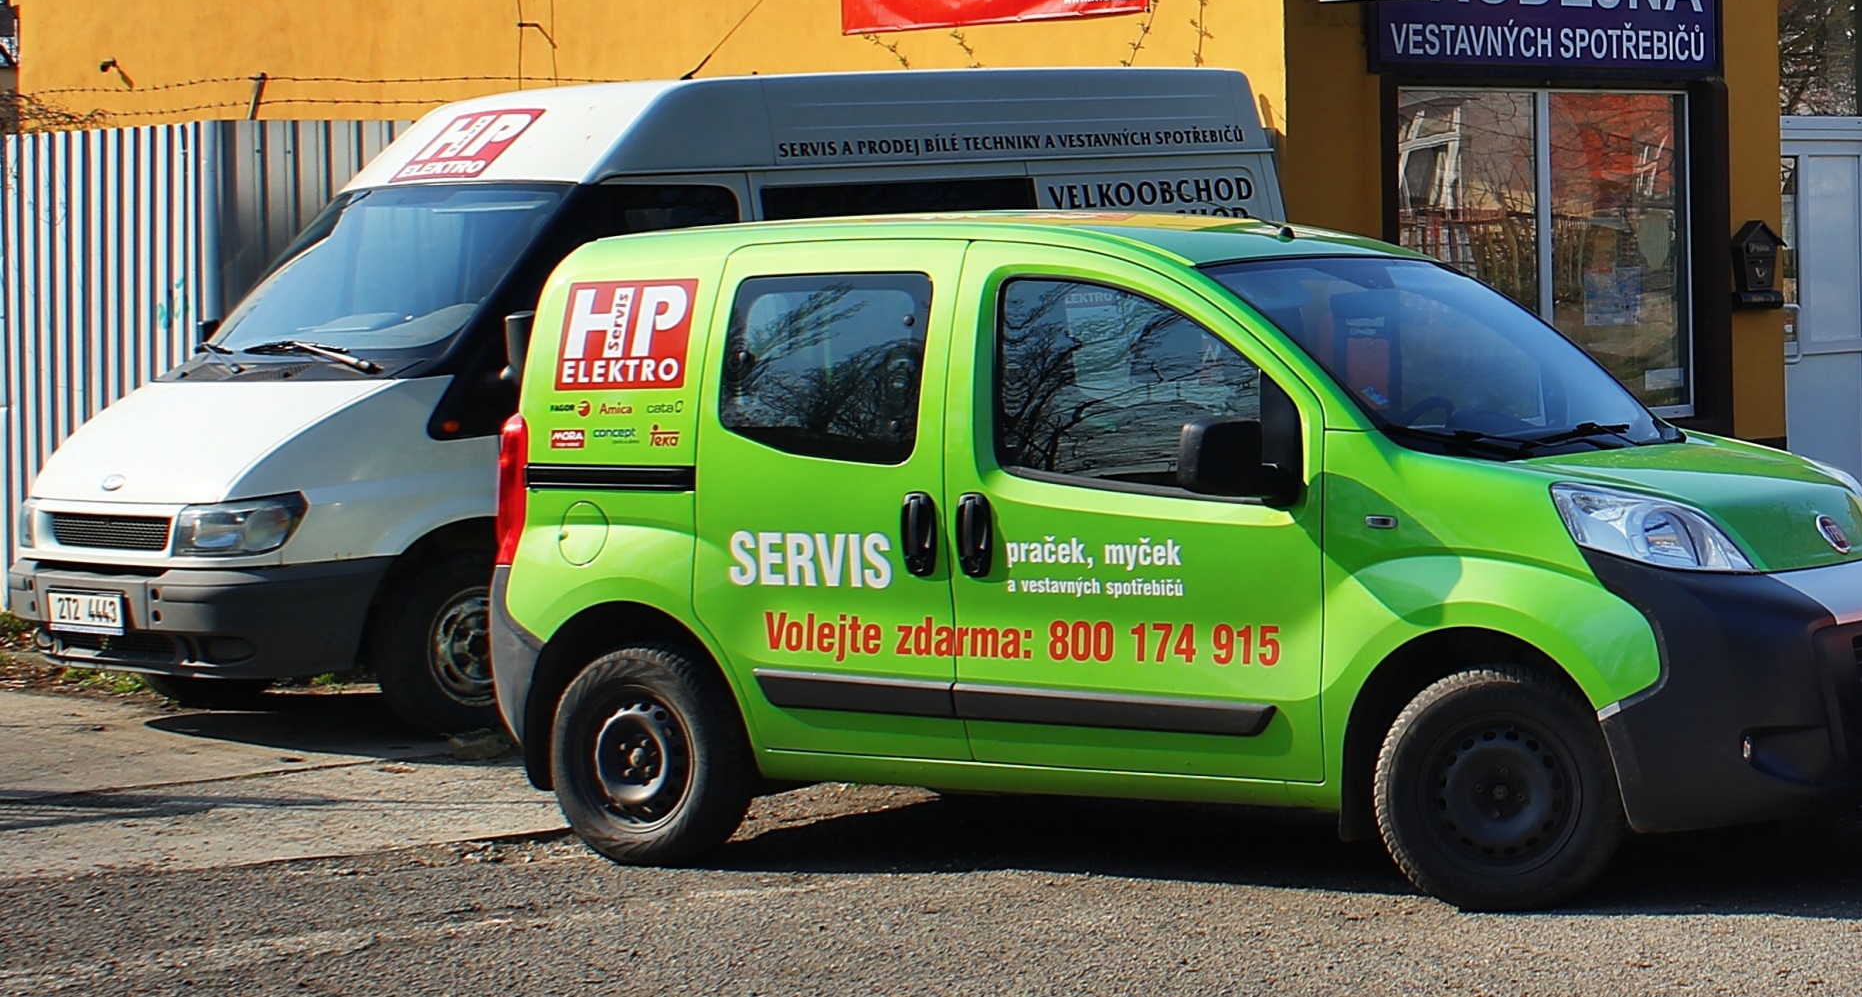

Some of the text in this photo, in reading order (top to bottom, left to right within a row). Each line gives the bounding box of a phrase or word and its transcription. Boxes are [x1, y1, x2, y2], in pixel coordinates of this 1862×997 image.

[1390, 19, 1705, 62] VESTAVNÝCH SPOTŘEBIČŮ
[414, 114, 532, 161] HP
[778, 124, 1243, 158] SERVIS A PRODEJ BÍLÉ TECHNIKY A VESTAVNÝCH SPOTŘEBIČŮ
[401, 160, 487, 176] ELEKTRO
[1048, 177, 1253, 209] VELKOOBCHOD
[563, 285, 688, 359] HP
[608, 293, 629, 351] Servis
[561, 358, 679, 383] ELEKTRO
[600, 402, 633, 414] Amica
[552, 431, 584, 441] MORA
[593, 428, 636, 439] concept
[729, 530, 892, 589] SERVIS
[1006, 536, 1182, 571] praček, myček
[1007, 576, 1184, 599] a vestavných spotřebičů
[58, 597, 81, 620] 2T2
[765, 611, 1280, 666] Volejte zdarma: 800 174 915
